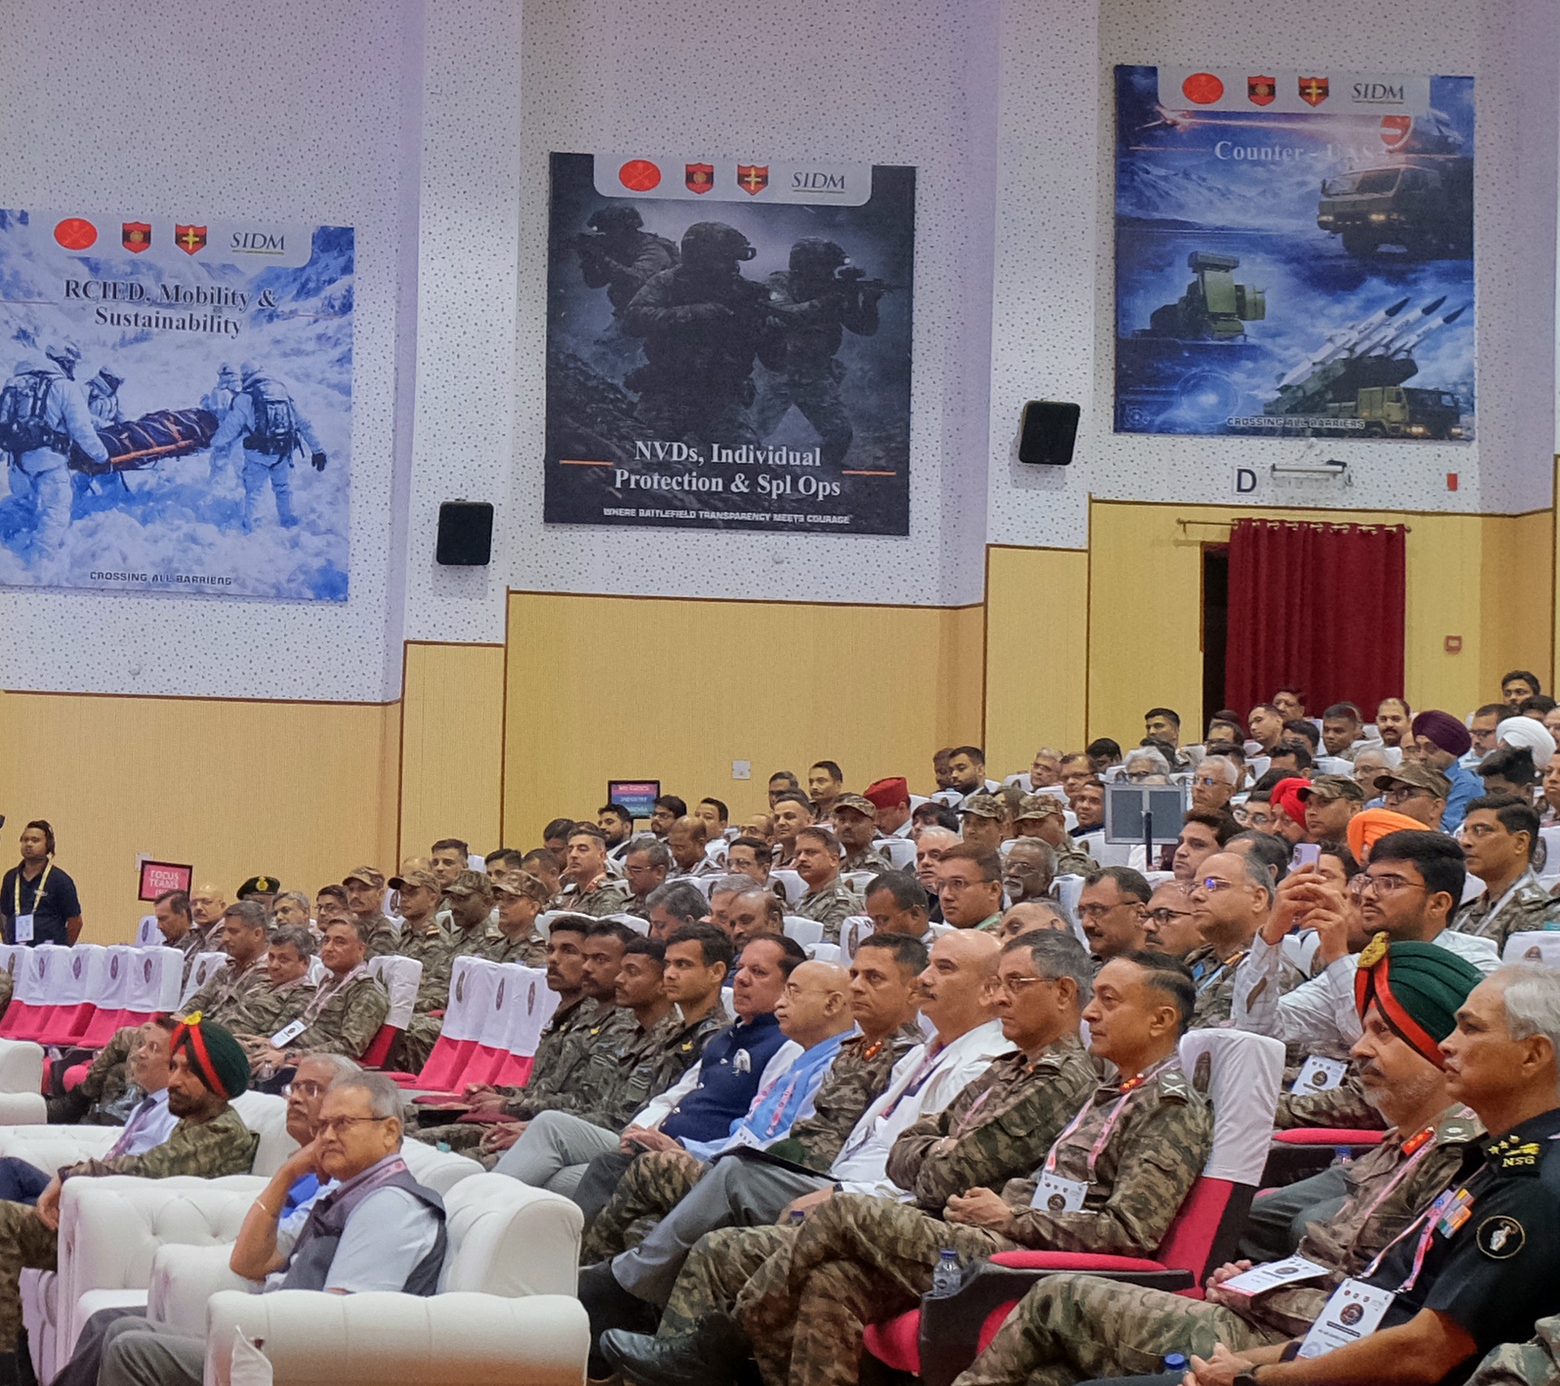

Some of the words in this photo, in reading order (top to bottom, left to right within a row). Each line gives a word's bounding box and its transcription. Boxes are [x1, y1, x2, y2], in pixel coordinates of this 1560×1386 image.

[1351, 83, 1404, 100] SIDM
[1214, 140, 1304, 160] Counter
[791, 171, 845, 189] SIDM
[229, 232, 286, 251] SIDM
[64, 279, 152, 305] RCIED,
[158, 283, 251, 311] Mobility
[257, 289, 277, 308] &
[95, 307, 243, 339] Sustainability
[1226, 416, 1284, 427] CROSSING
[634, 440, 705, 466] NVDs,
[711, 443, 821, 467] Individual
[614, 468, 724, 492] Protection
[730, 473, 750, 493] &
[756, 473, 792, 499] Spl
[798, 475, 842, 501] Ops
[1236, 468, 1257, 493] D
[603, 507, 637, 518] WHERE
[639, 508, 697, 520] BATTLEFIELD
[698, 510, 772, 522] TRANSPARENCY
[773, 512, 805, 524] MEETS
[806, 514, 851, 525] COURAGE
[89, 571, 148, 583] CROSSING
[175, 575, 233, 586] BARRIERS
[1501, 1155, 1536, 1167] NSG
